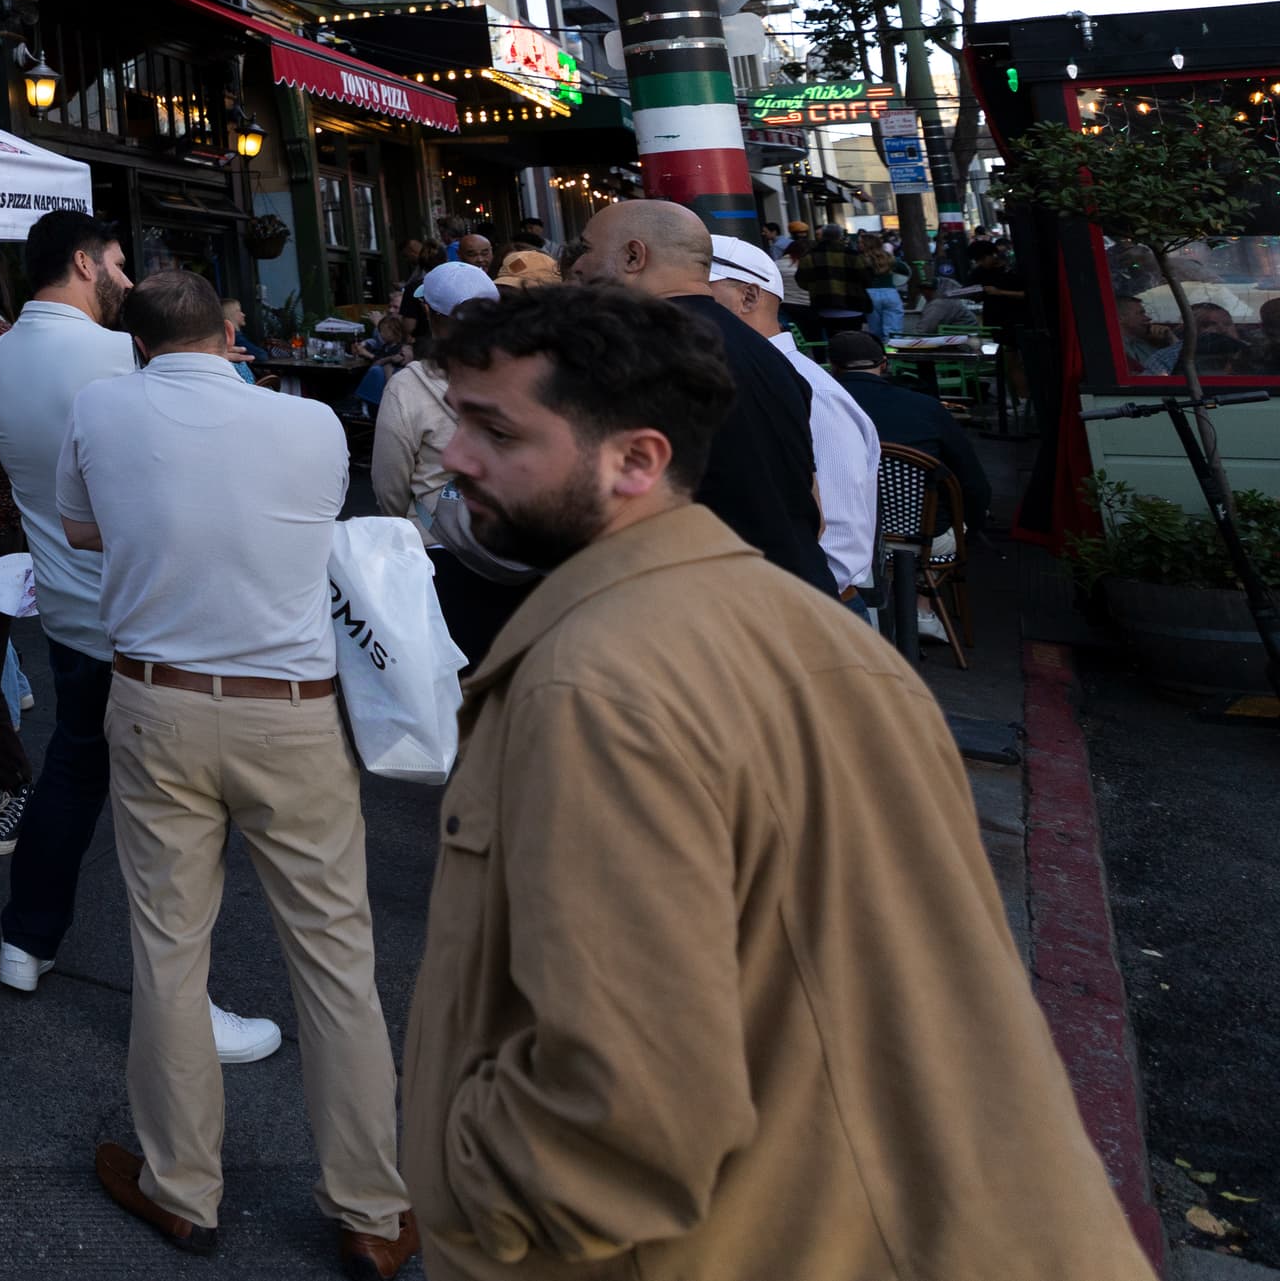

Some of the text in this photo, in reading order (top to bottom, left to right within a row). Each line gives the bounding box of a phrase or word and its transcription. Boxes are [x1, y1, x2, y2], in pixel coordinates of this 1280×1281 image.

[340, 71, 410, 112] TONY'S PIZZA
[804, 83, 863, 100] Nik's
[808, 100, 889, 120] CAFE
[6, 193, 32, 209] PIZZA
[33, 194, 88, 213] NAPOLETANA
